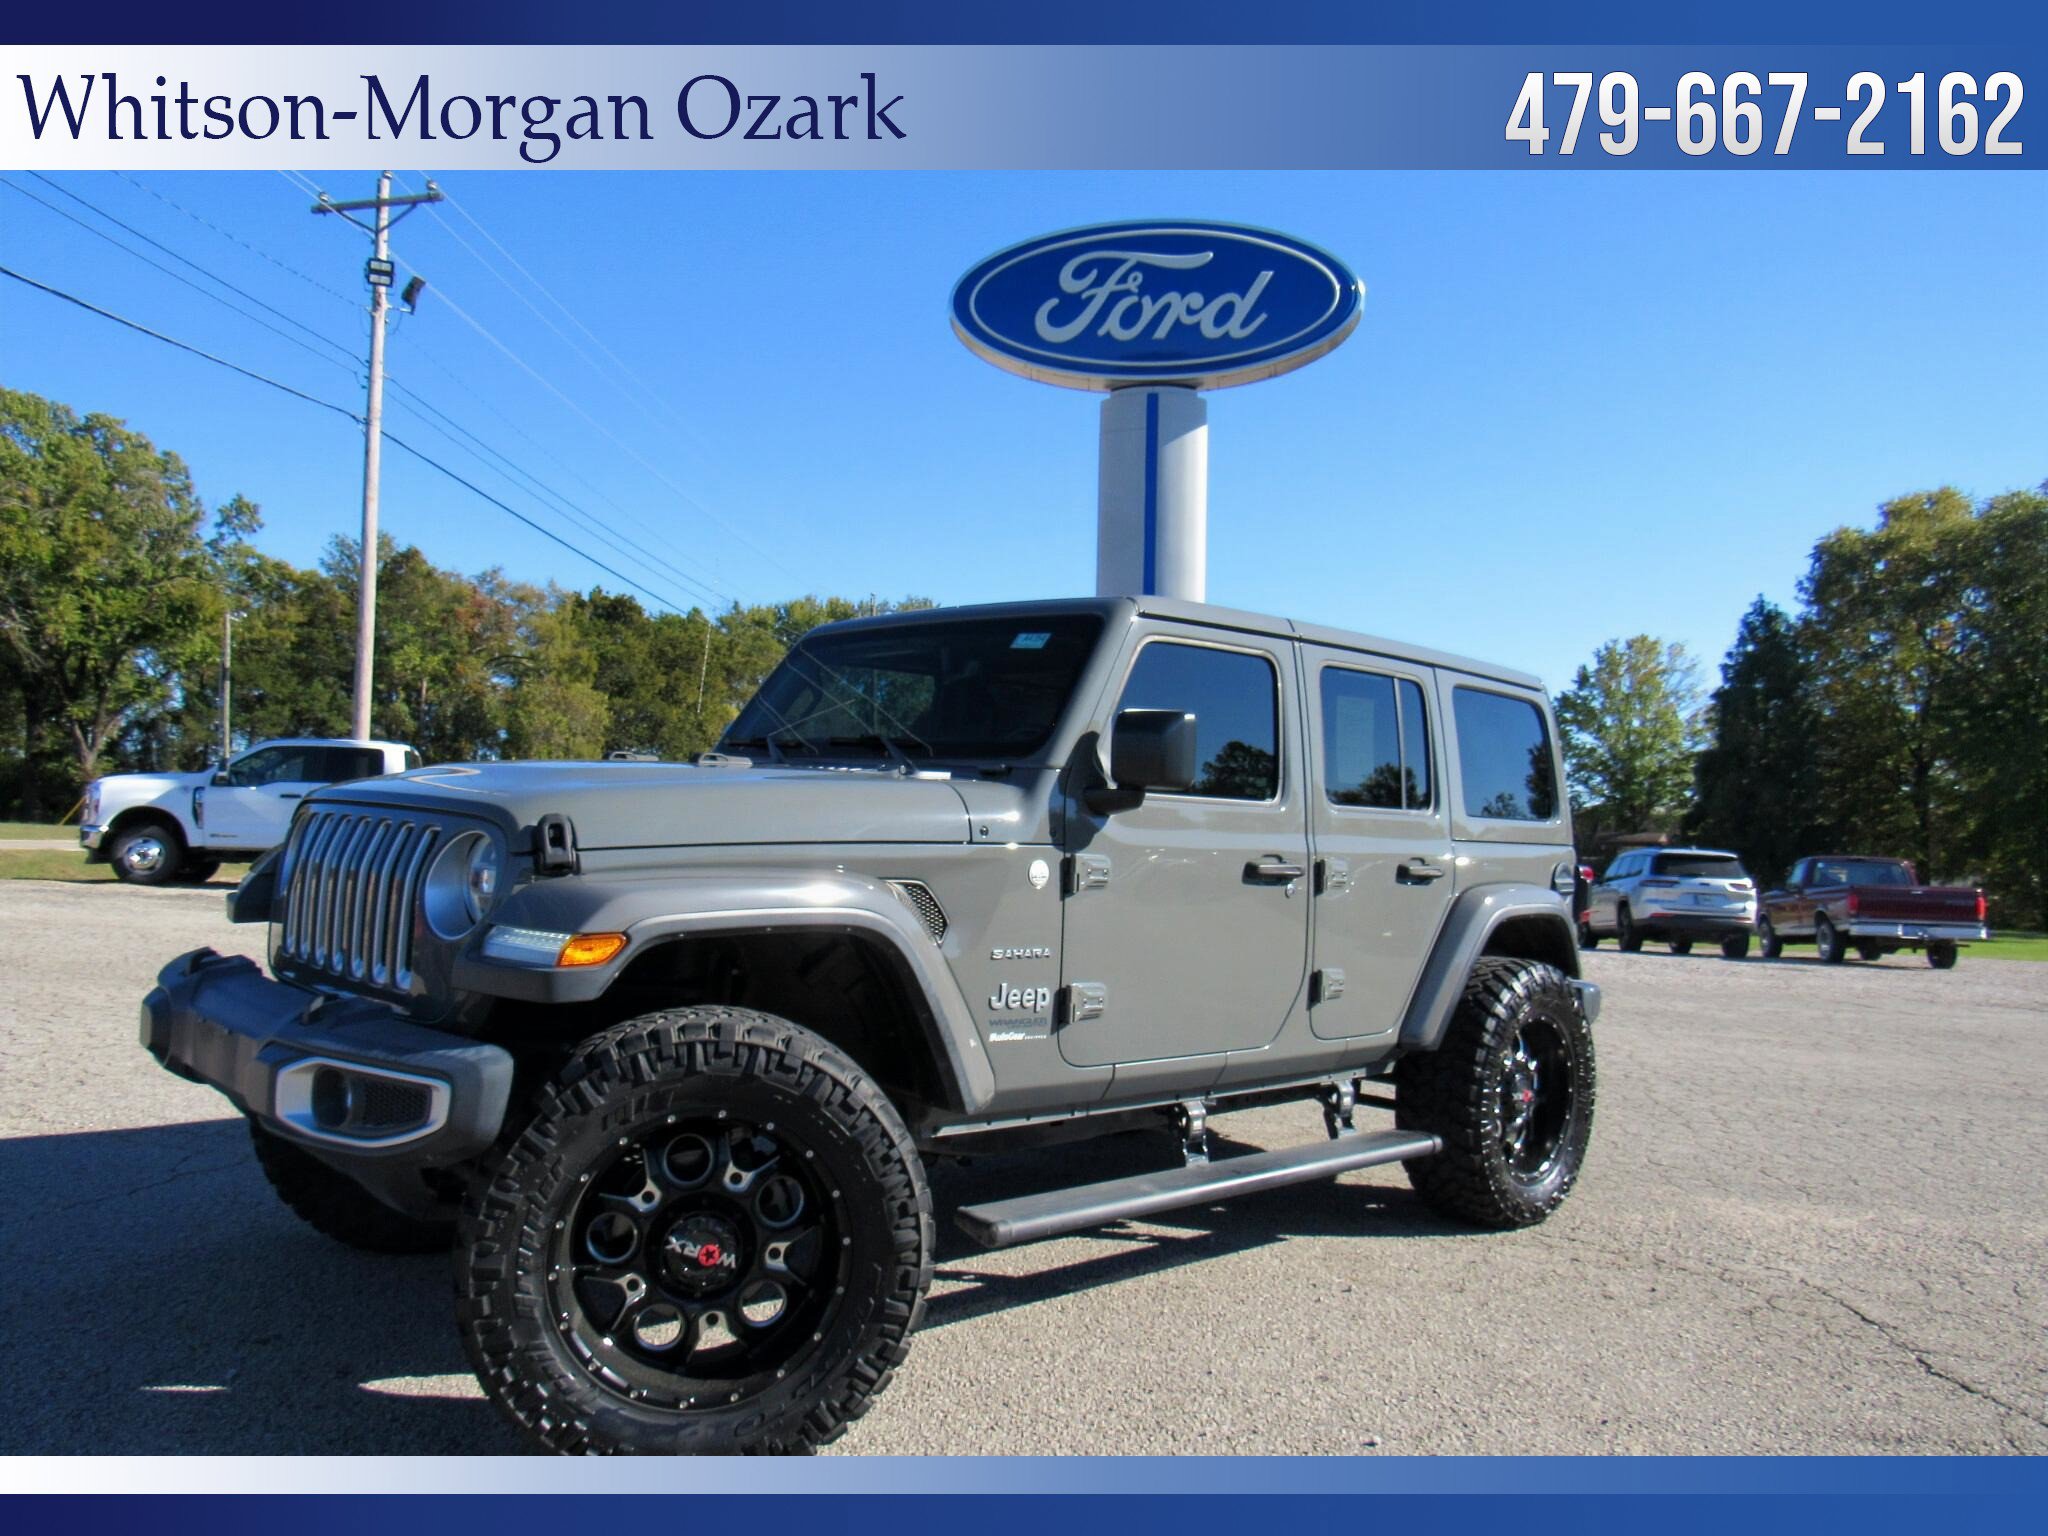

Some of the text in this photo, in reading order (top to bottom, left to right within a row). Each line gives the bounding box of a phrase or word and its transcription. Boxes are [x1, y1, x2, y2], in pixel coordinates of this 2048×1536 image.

[1034, 250, 1275, 344] Ford
[991, 947, 1051, 960] SAHARA
[989, 982, 1050, 1013] Jeep
